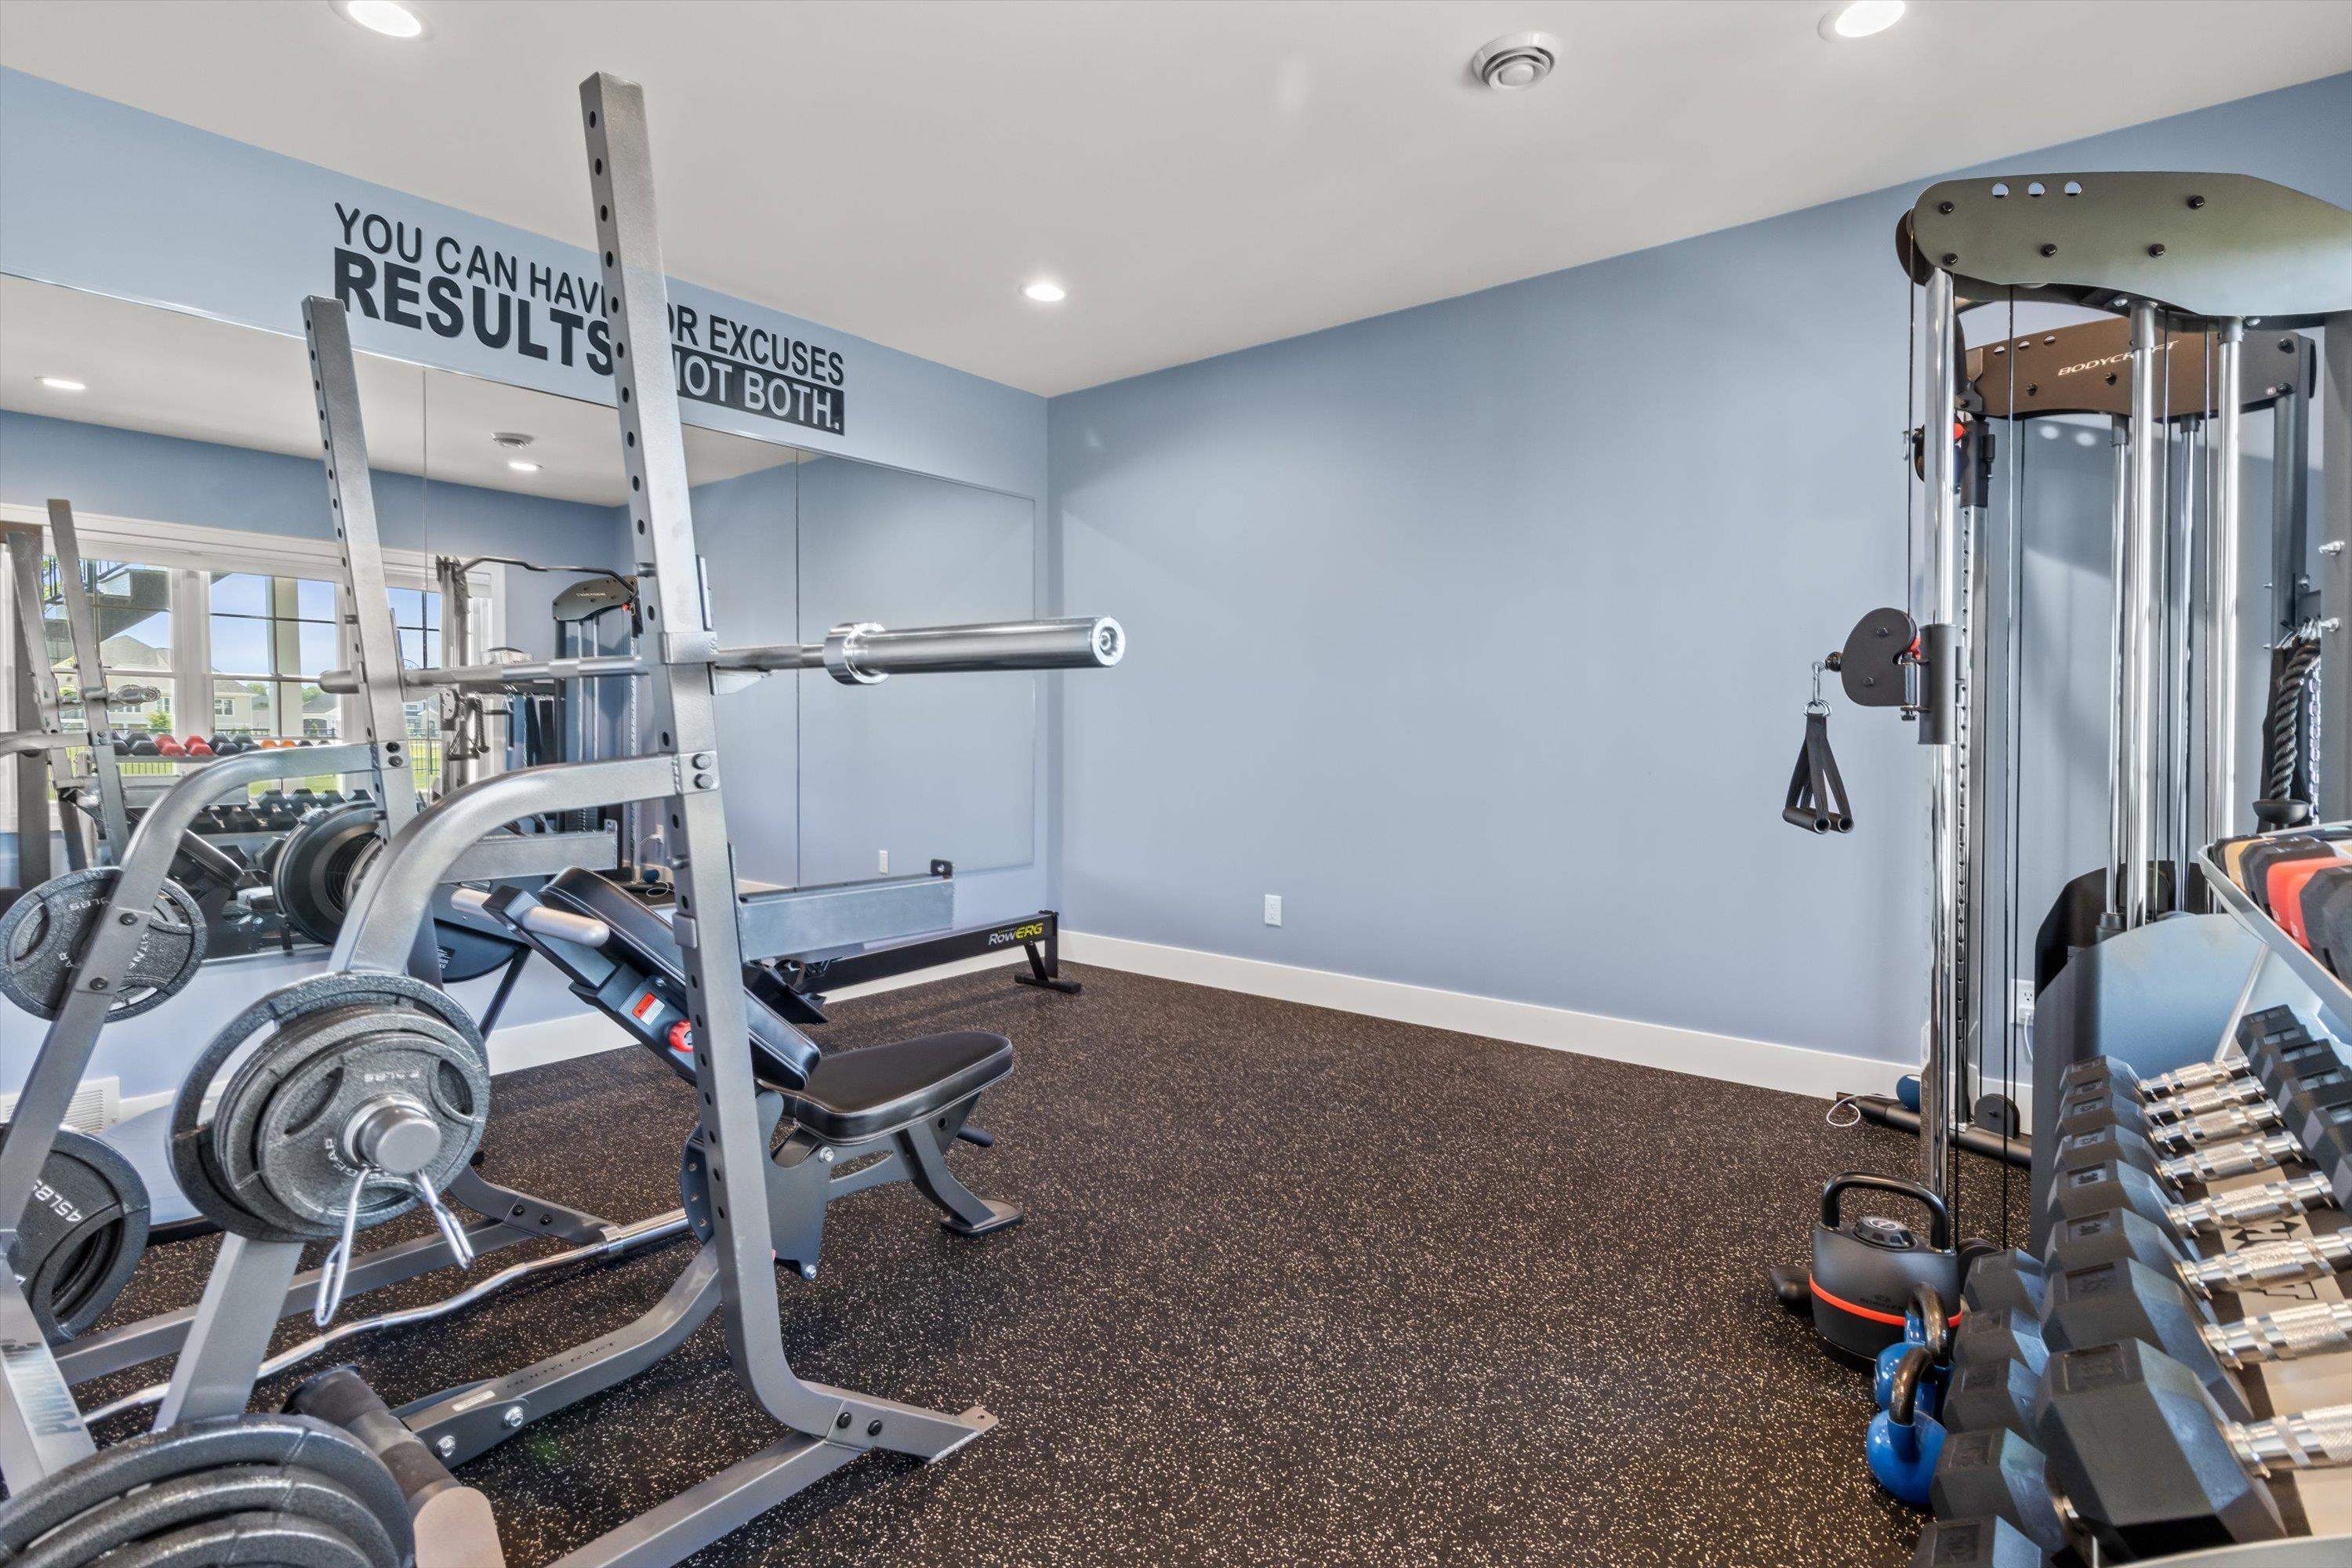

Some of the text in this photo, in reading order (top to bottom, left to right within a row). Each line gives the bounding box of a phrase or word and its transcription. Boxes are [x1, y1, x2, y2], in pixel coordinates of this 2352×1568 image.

[334, 247, 614, 376] RESULTS
[744, 370, 840, 430] BOTH.
[335, 202, 844, 387] YOU CAN HAV R EXCUSES
